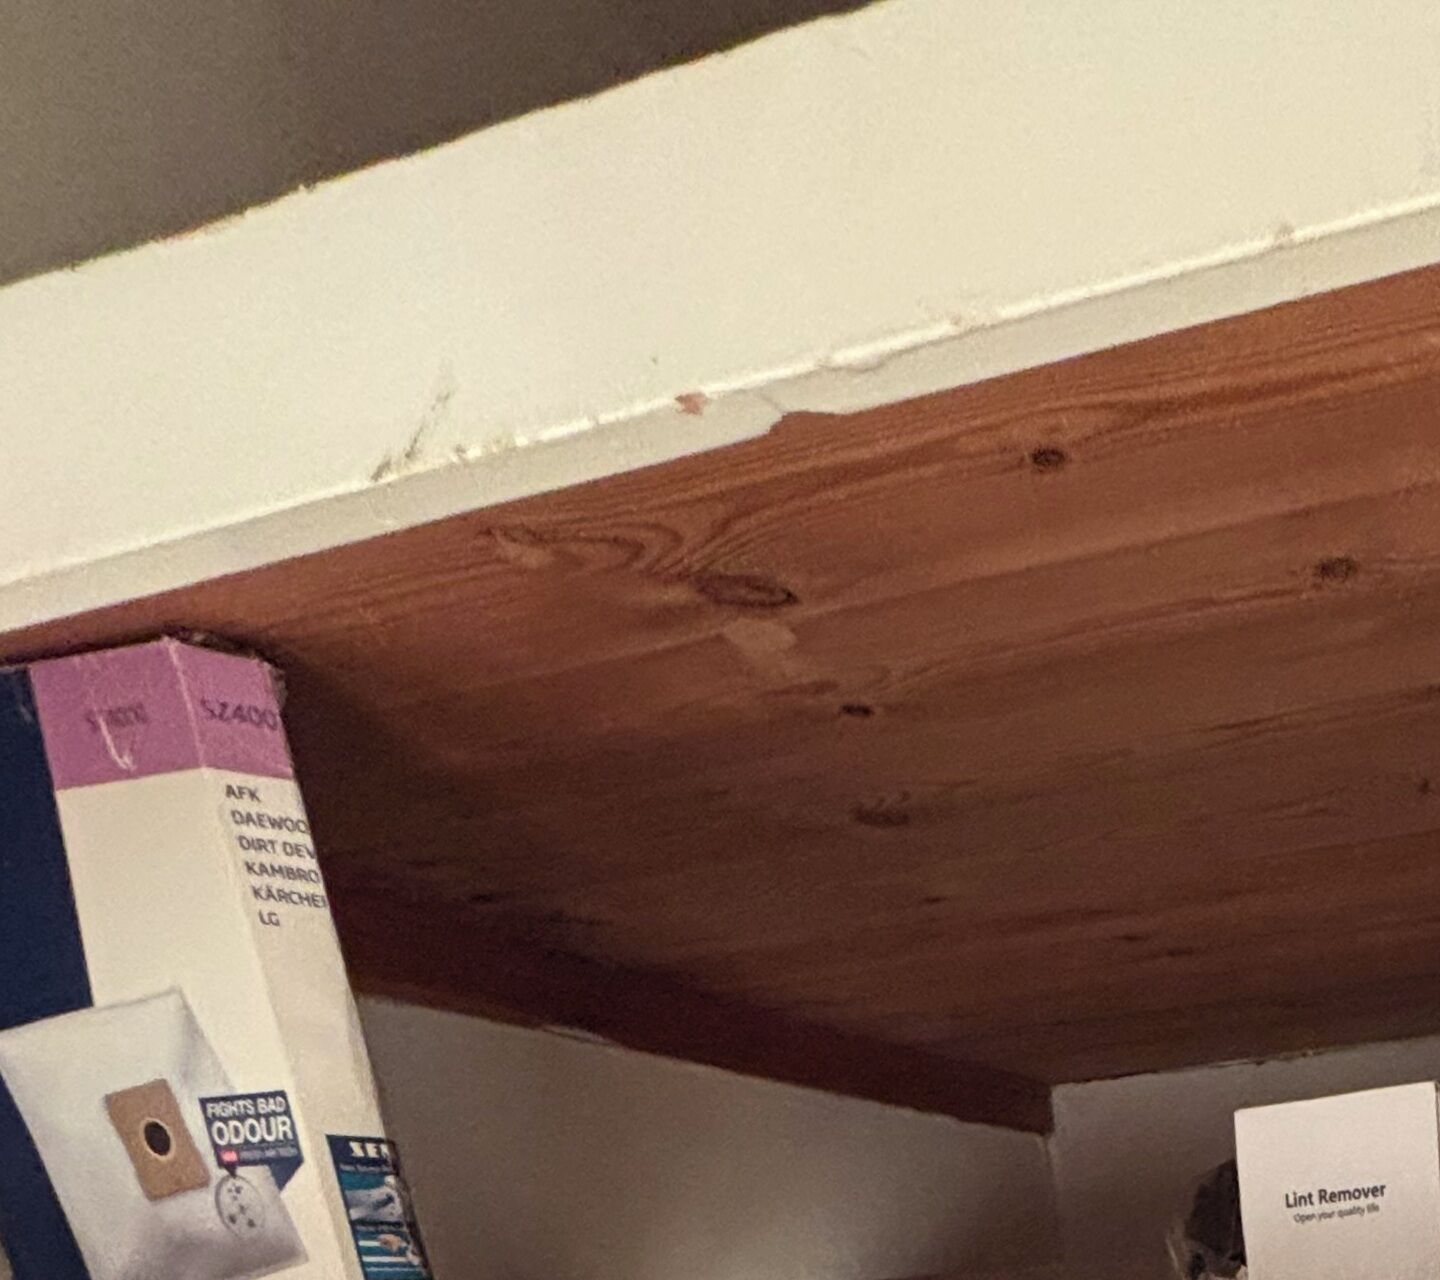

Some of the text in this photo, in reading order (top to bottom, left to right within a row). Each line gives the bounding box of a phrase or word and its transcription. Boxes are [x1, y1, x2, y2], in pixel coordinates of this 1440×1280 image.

[226, 784, 261, 801] AFK
[237, 834, 278, 854] DIRT
[251, 884, 328, 908] KÄRCHE
[258, 909, 280, 926] LG
[206, 1096, 286, 1118] FIGHTS BAD
[211, 1115, 294, 1145] ODOUR
[1285, 1185, 1386, 1208] Lint Remover
